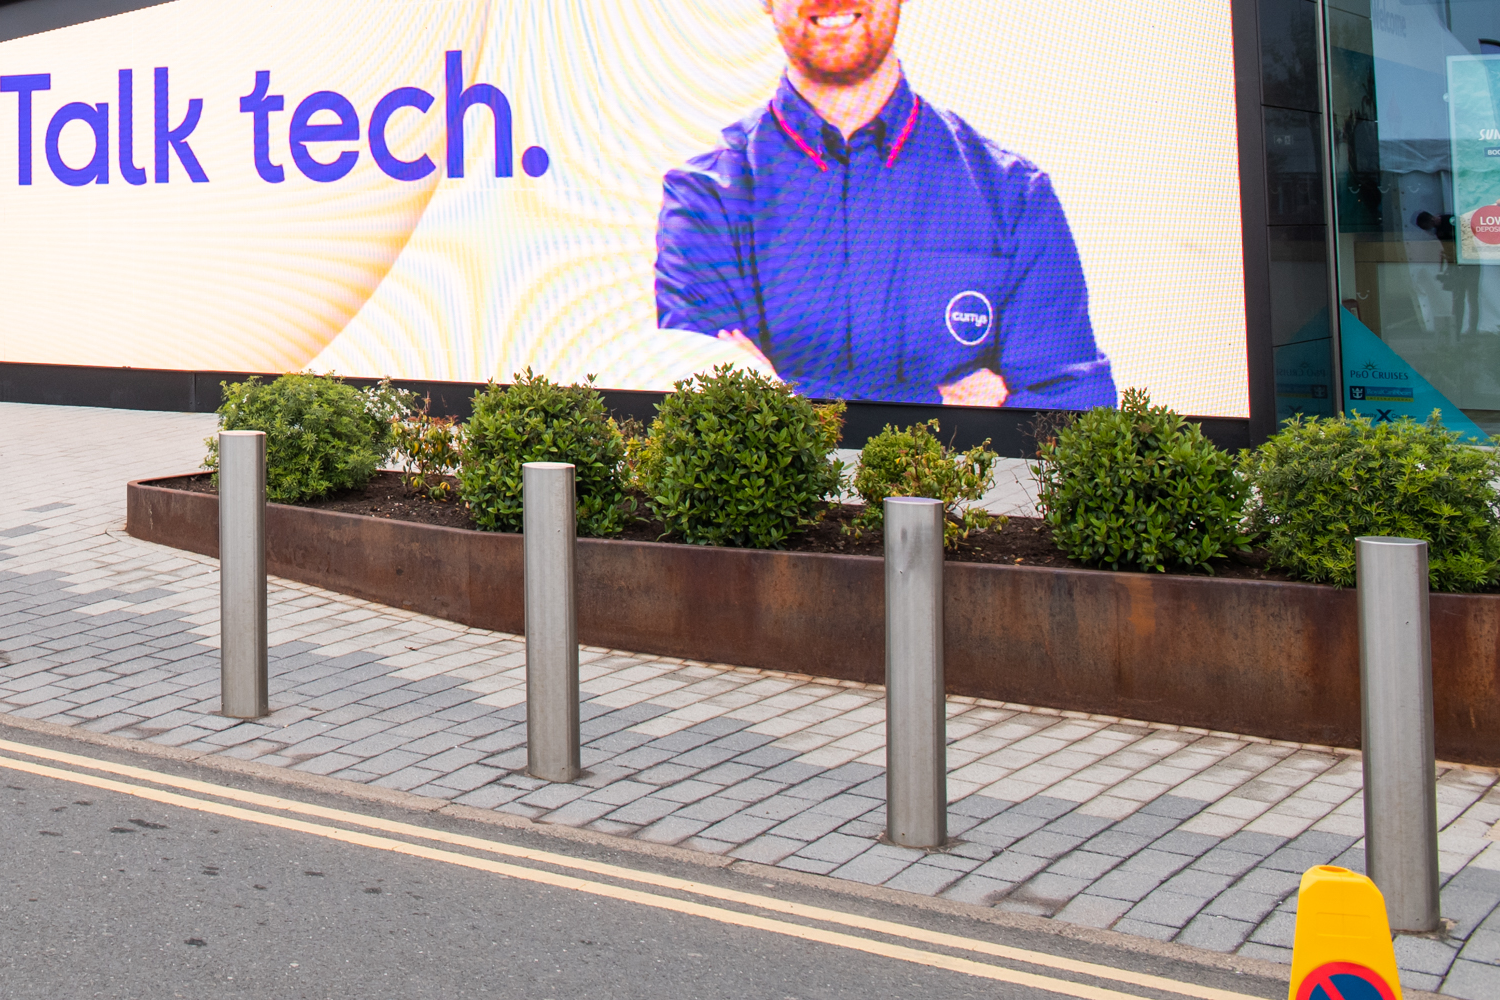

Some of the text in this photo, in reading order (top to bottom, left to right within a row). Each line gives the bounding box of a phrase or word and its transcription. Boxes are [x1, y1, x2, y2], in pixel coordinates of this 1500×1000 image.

[0, 49, 550, 186] Talk tech.
[952, 311, 988, 327] currys
[1350, 370, 1408, 380] P&O CRUISES
